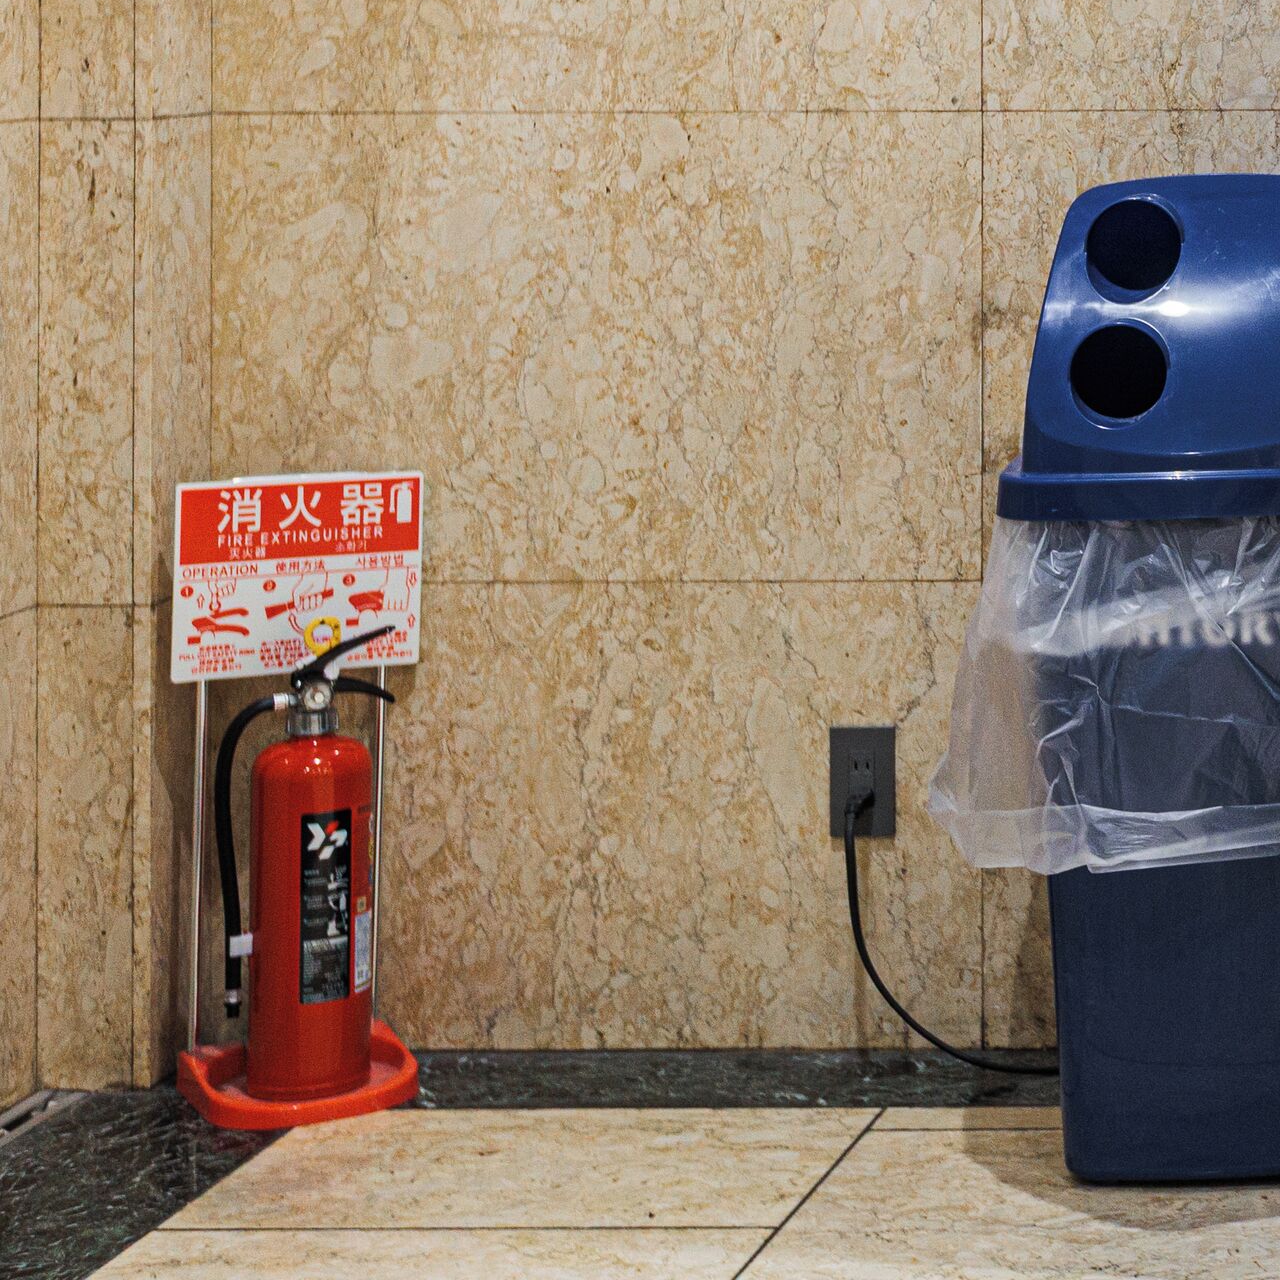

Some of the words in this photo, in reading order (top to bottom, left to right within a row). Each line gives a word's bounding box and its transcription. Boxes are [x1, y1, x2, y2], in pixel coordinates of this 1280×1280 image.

[217, 482, 384, 533] 消火器
[218, 533, 254, 548] FIRE
[261, 526, 383, 545] EXTINGUISHER
[276, 560, 326, 574] 使用方法
[356, 554, 405, 568] 사용방법
[182, 564, 258, 578] OPERATION
